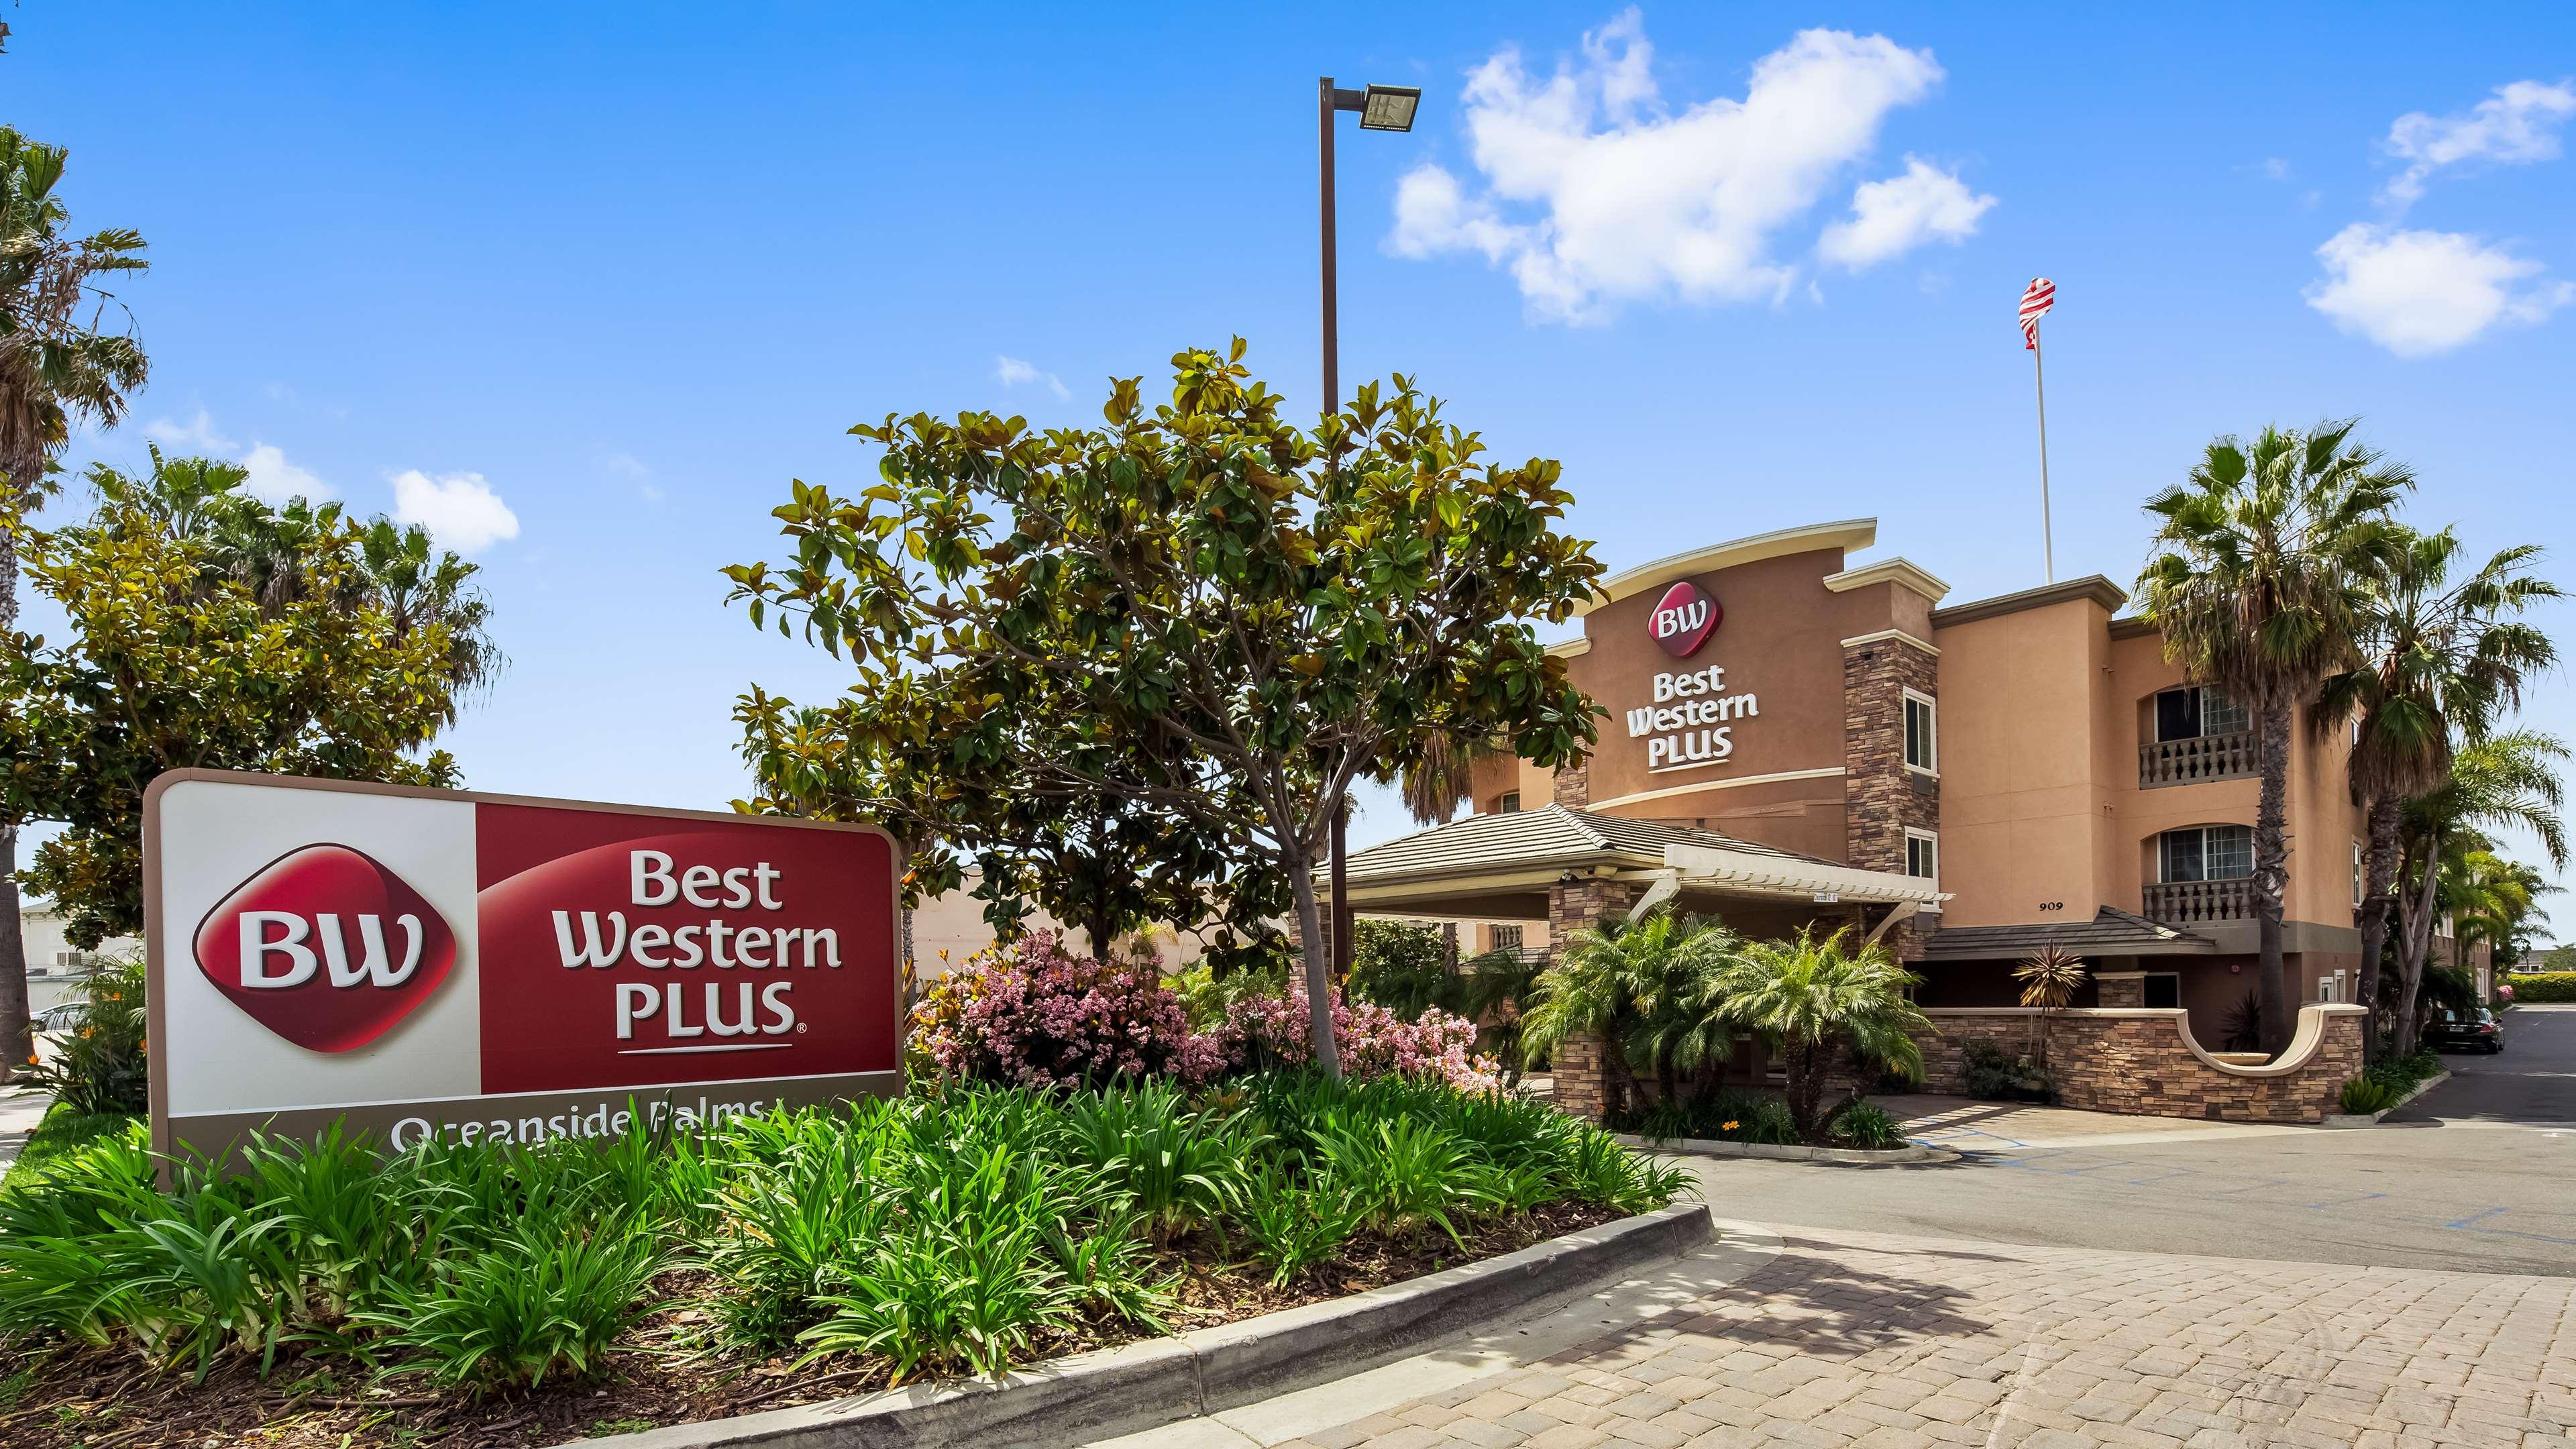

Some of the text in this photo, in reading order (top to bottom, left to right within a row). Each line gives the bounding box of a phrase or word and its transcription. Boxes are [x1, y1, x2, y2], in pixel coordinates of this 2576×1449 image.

[1657, 600, 1707, 638] BW
[1654, 665, 1726, 702] Best
[1626, 693, 1760, 737] Western
[1648, 727, 1733, 767] PLUS
[631, 850, 782, 910] Best
[2039, 902, 2063, 912] 909
[239, 911, 423, 987] BW
[551, 910, 842, 968] Western
[390, 1096, 765, 1154] Oceanside Palms
